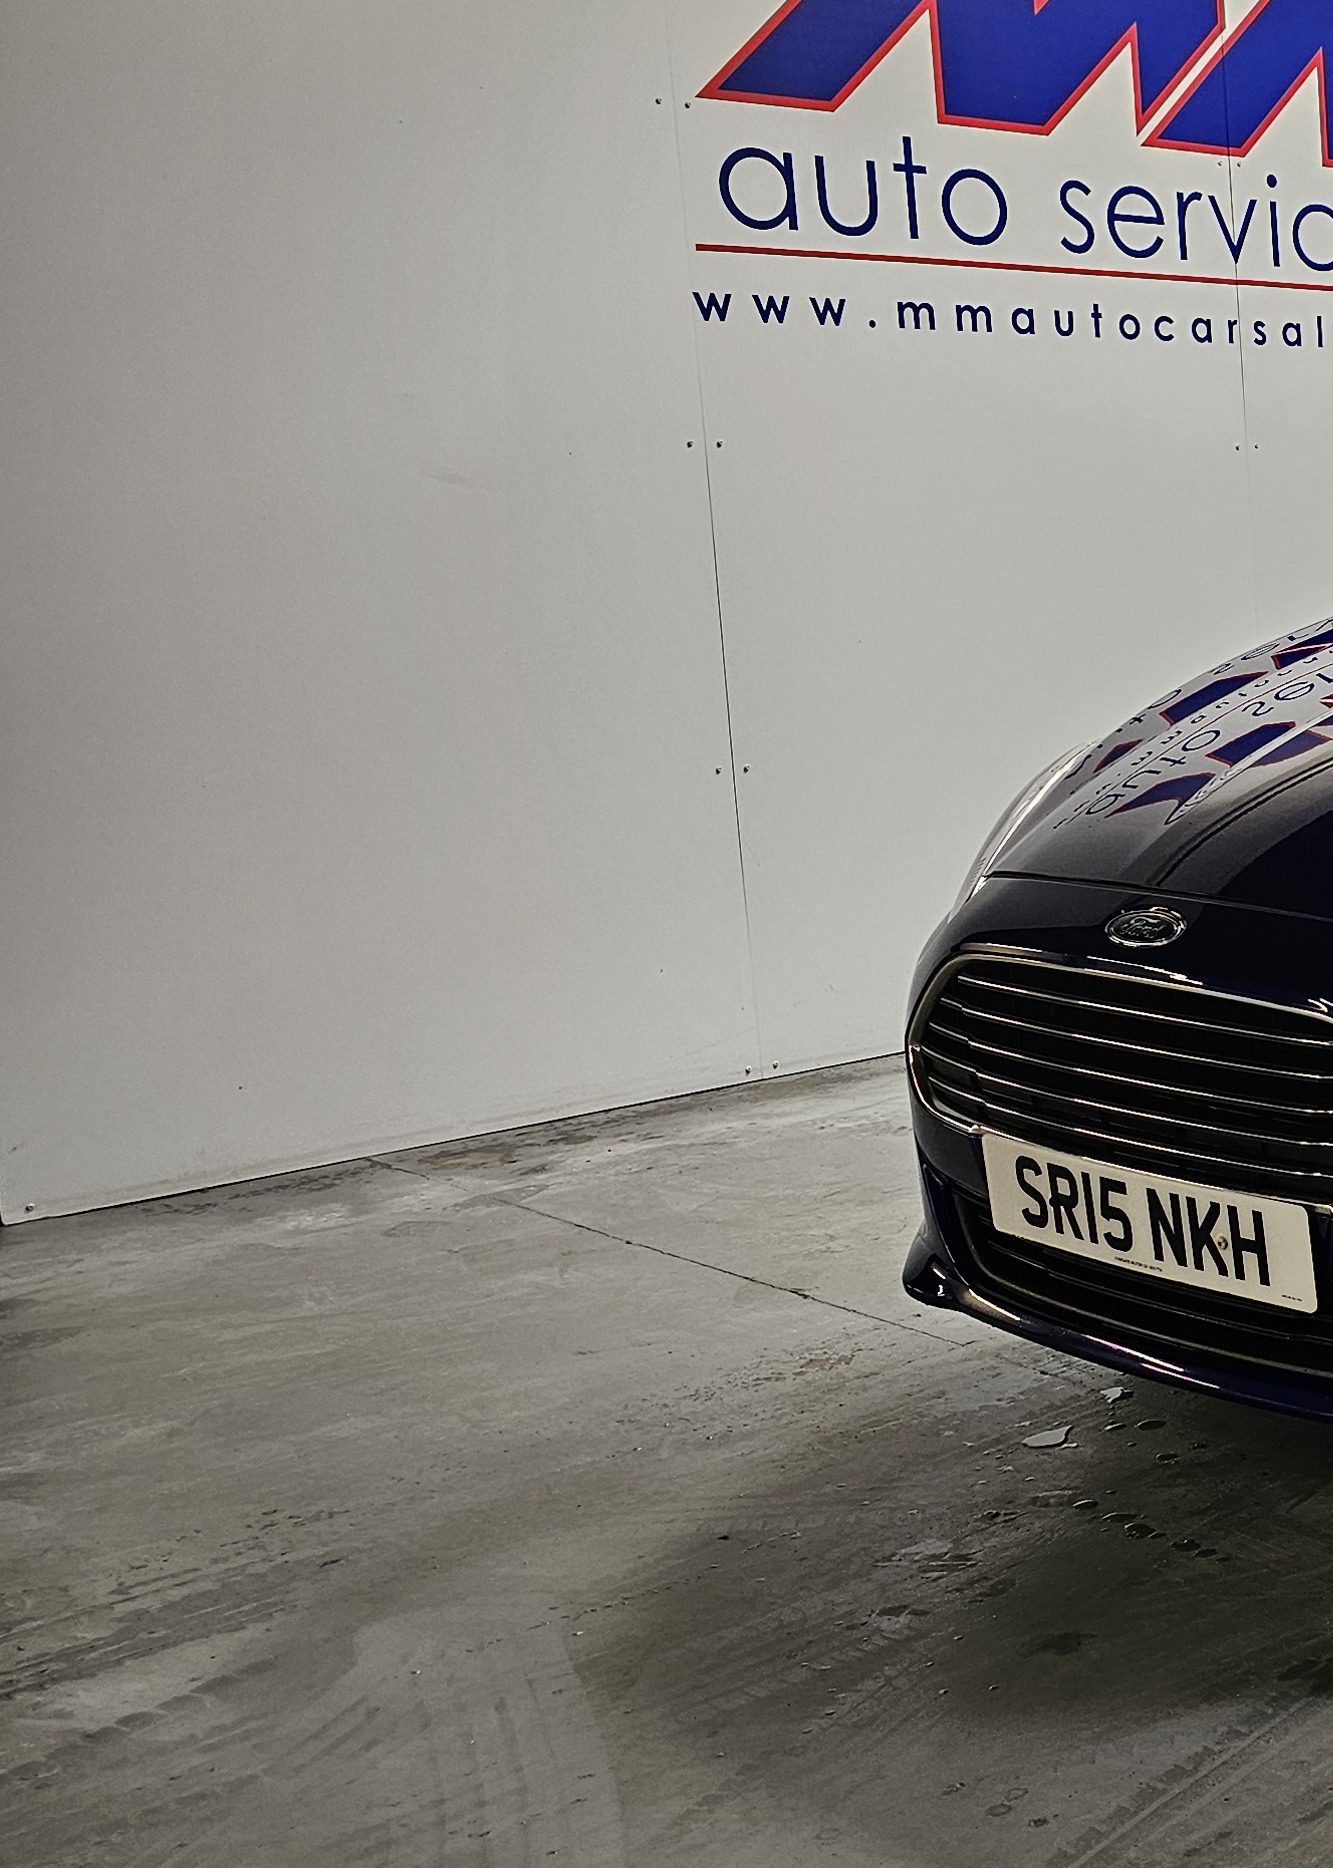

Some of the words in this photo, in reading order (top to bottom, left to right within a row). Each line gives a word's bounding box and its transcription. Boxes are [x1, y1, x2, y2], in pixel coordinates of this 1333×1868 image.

[718, 136, 1008, 244] auto
[1014, 1155, 1134, 1253] SR15
[1145, 1187, 1272, 1287] NKH
